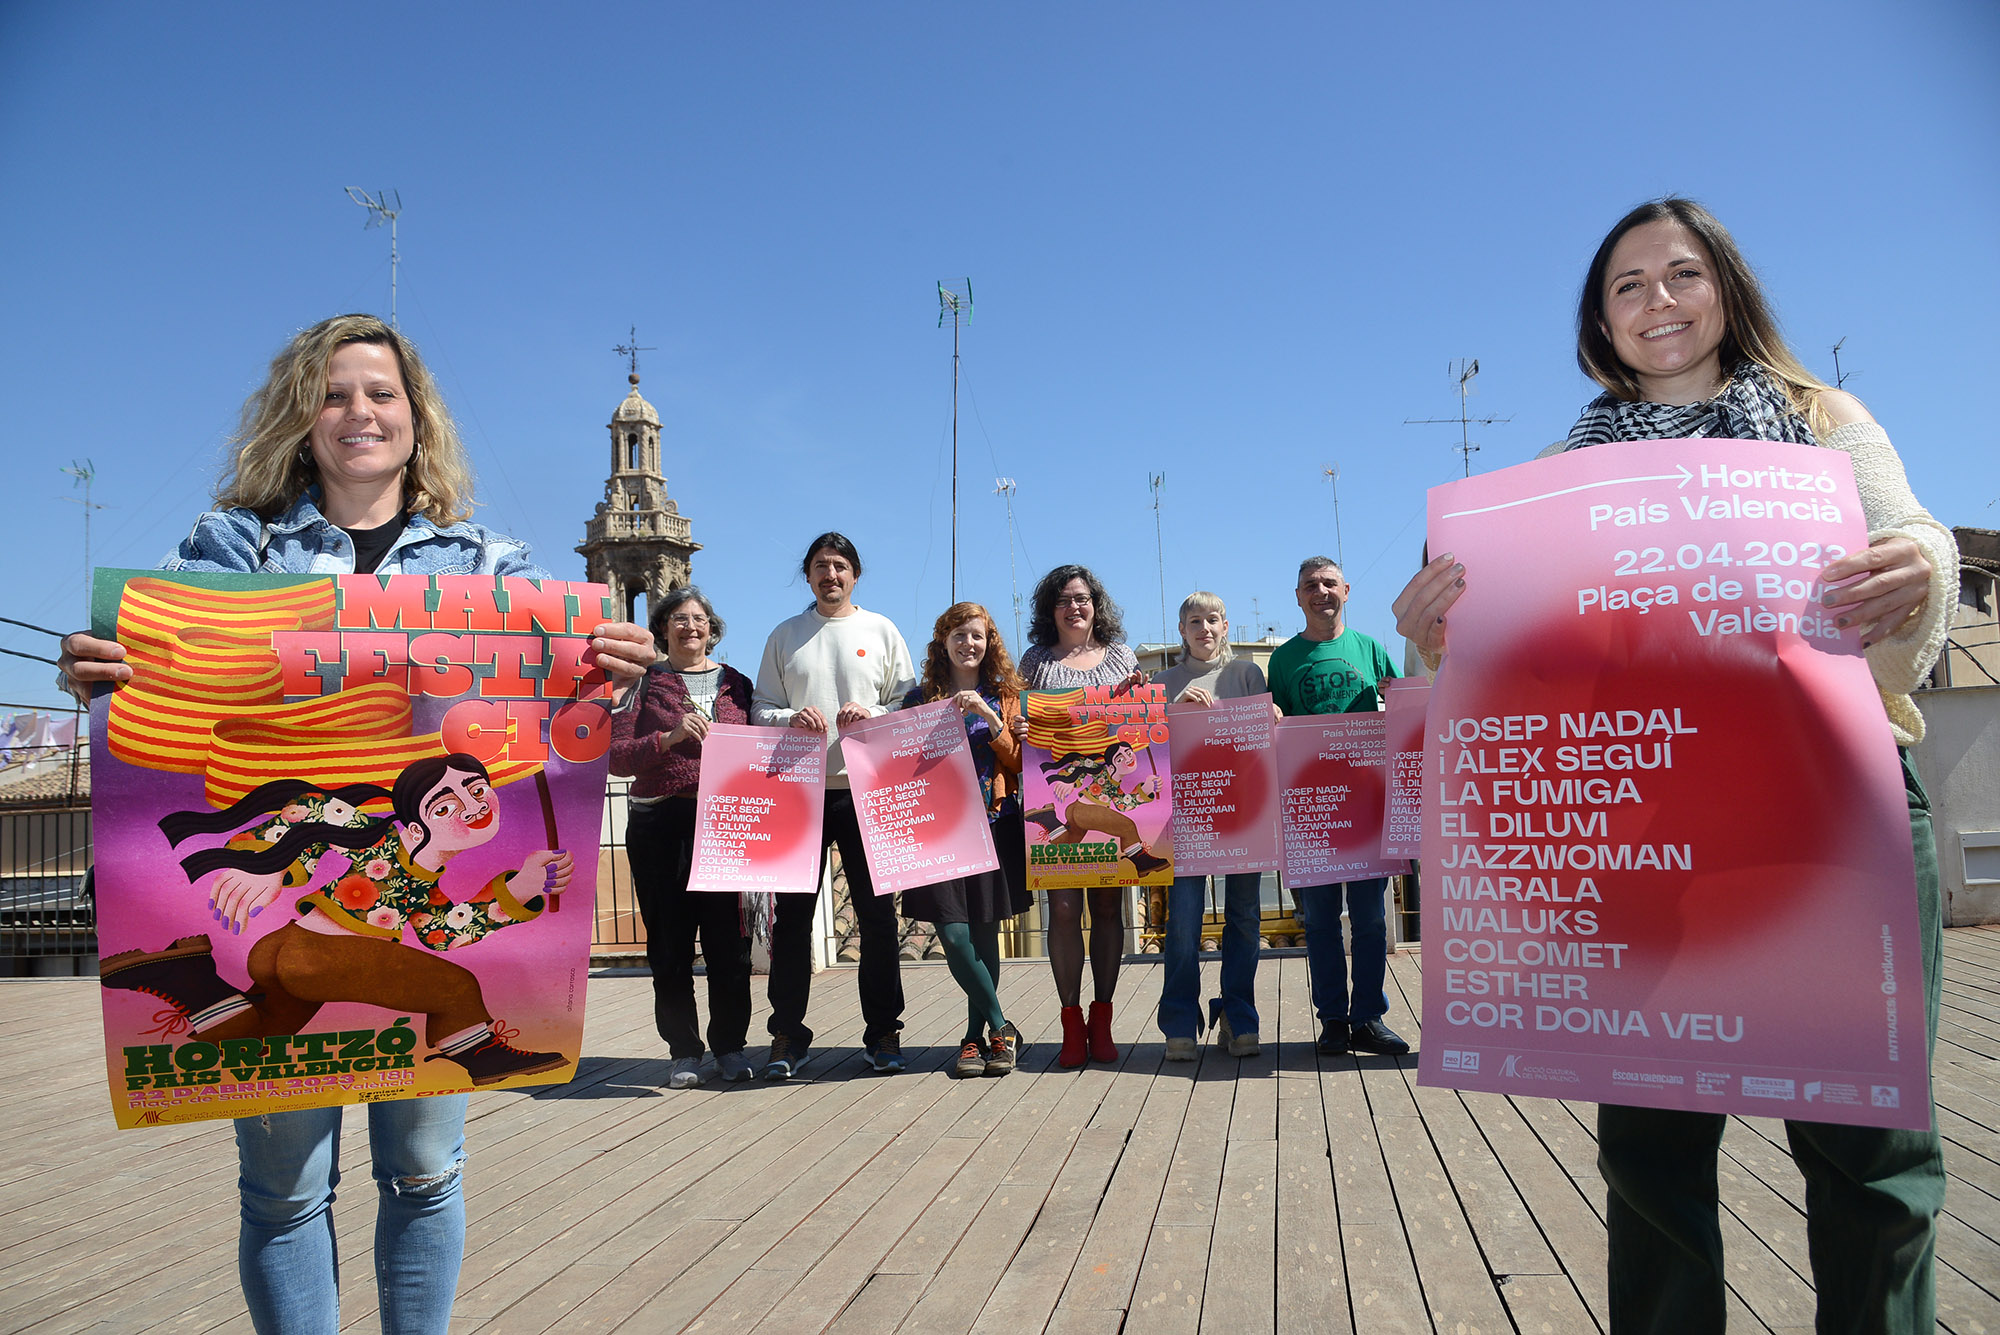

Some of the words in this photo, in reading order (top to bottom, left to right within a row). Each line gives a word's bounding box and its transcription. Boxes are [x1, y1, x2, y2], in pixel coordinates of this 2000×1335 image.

[1701, 464, 1836, 494] Horitzó
[1590, 498, 1670, 530] País
[1680, 494, 1842, 524] Valencià
[1578, 584, 1678, 614] Plaça
[1692, 576, 1743, 602] de
[338, 574, 612, 634] MANI
[1689, 606, 1840, 639] València
[272, 631, 613, 701] FESTA
[1304, 671, 1358, 694] STOP
[918, 706, 954, 721] Horitzó
[1067, 704, 1168, 725] FESTA
[1235, 702, 1267, 712] Horitzó
[1215, 723, 1269, 736] 22.04.2023
[1439, 715, 1548, 743] JOSEP
[1560, 708, 1697, 739] NADAL
[785, 735, 820, 743] Horitzó
[901, 727, 959, 747] 22.04.2023
[1205, 737, 1232, 747] Plaça
[1234, 735, 1246, 743] de
[1248, 733, 1270, 742] Bous
[892, 747, 919, 760] Plaça
[922, 743, 934, 751] de
[937, 737, 962, 748] Bous
[1454, 743, 1545, 774] ÀLEX
[1556, 735, 1672, 772] SEGUÍ
[761, 756, 820, 765] 22.04.2023
[1319, 752, 1346, 761] Plaça
[749, 764, 776, 774] Plaça
[795, 766, 819, 774] Bous
[1202, 770, 1236, 779] NADAL
[860, 786, 892, 801] JOSEP
[895, 778, 930, 792] NADAL
[1281, 787, 1314, 797] JOSEP
[1316, 785, 1351, 795] NADAL
[1440, 781, 1483, 806] LA
[1493, 773, 1642, 805] FÚMIGA
[705, 795, 738, 804] JOSEP
[741, 796, 776, 806] NADAL
[1184, 798, 1214, 806] DILUVI
[863, 809, 877, 817] LA
[865, 818, 878, 826] EL
[881, 809, 912, 823] DILUVI
[1282, 806, 1295, 814] LA
[868, 813, 935, 835] JAZZWOMAN
[1283, 815, 1295, 823] EL
[1298, 813, 1330, 823] DILUVI
[1441, 813, 1479, 837] EL
[1490, 812, 1607, 838] DILUVI
[703, 822, 715, 830] EL
[718, 823, 751, 831] DILUVI
[1284, 820, 1352, 832] JAZZWOMAN
[702, 831, 771, 841] JAZZWOMAN
[869, 827, 914, 843] MARALA
[1173, 832, 1220, 842] COLOMET
[1284, 830, 1330, 841] MARALA
[701, 840, 746, 848] MARALA
[871, 836, 915, 851] MALUKS
[1030, 838, 1118, 857] HORITZÓ
[1174, 842, 1211, 851] ESTHER
[1286, 839, 1329, 850] MALUKS
[700, 848, 744, 857] MALUKS
[873, 843, 923, 860] COLOMET
[1174, 851, 1194, 860] COR
[1197, 850, 1226, 859] DONA
[1228, 848, 1248, 856] VEU
[1286, 848, 1337, 858] COLOMET
[1441, 844, 1692, 870] JAZZWOMAN
[700, 857, 751, 866] COLOMET
[875, 854, 915, 869] ESTHER
[877, 866, 900, 877] COR
[903, 859, 932, 872] DONA
[934, 854, 955, 865] VEU
[1288, 857, 1328, 868] ESTHER
[1288, 866, 1312, 876] COR
[1314, 863, 1344, 873] DONA
[1347, 862, 1368, 870] VEU
[699, 866, 739, 874] ESTHER
[1442, 876, 1602, 903] MARALA
[1443, 906, 1598, 935] MALUKS
[1443, 938, 1628, 969] COLOMET
[1446, 969, 1589, 1000] ESTHER
[1445, 1001, 1524, 1029] COR
[1536, 1005, 1650, 1038] DONA
[1660, 1012, 1744, 1043] VEU
[123, 1016, 417, 1078] HORITZÓ
[1464, 1055, 1477, 1066] 21
[128, 1090, 165, 1101] 22
[173, 1081, 279, 1099] D'ABRIL
[285, 1074, 355, 1089] 2023
[377, 1070, 415, 1082] 18h
[128, 1098, 182, 1110] Plaça
[188, 1094, 213, 1104] de
[218, 1090, 261, 1103] Sant
[268, 1087, 325, 1099] Agustí
[347, 1078, 414, 1092] València
